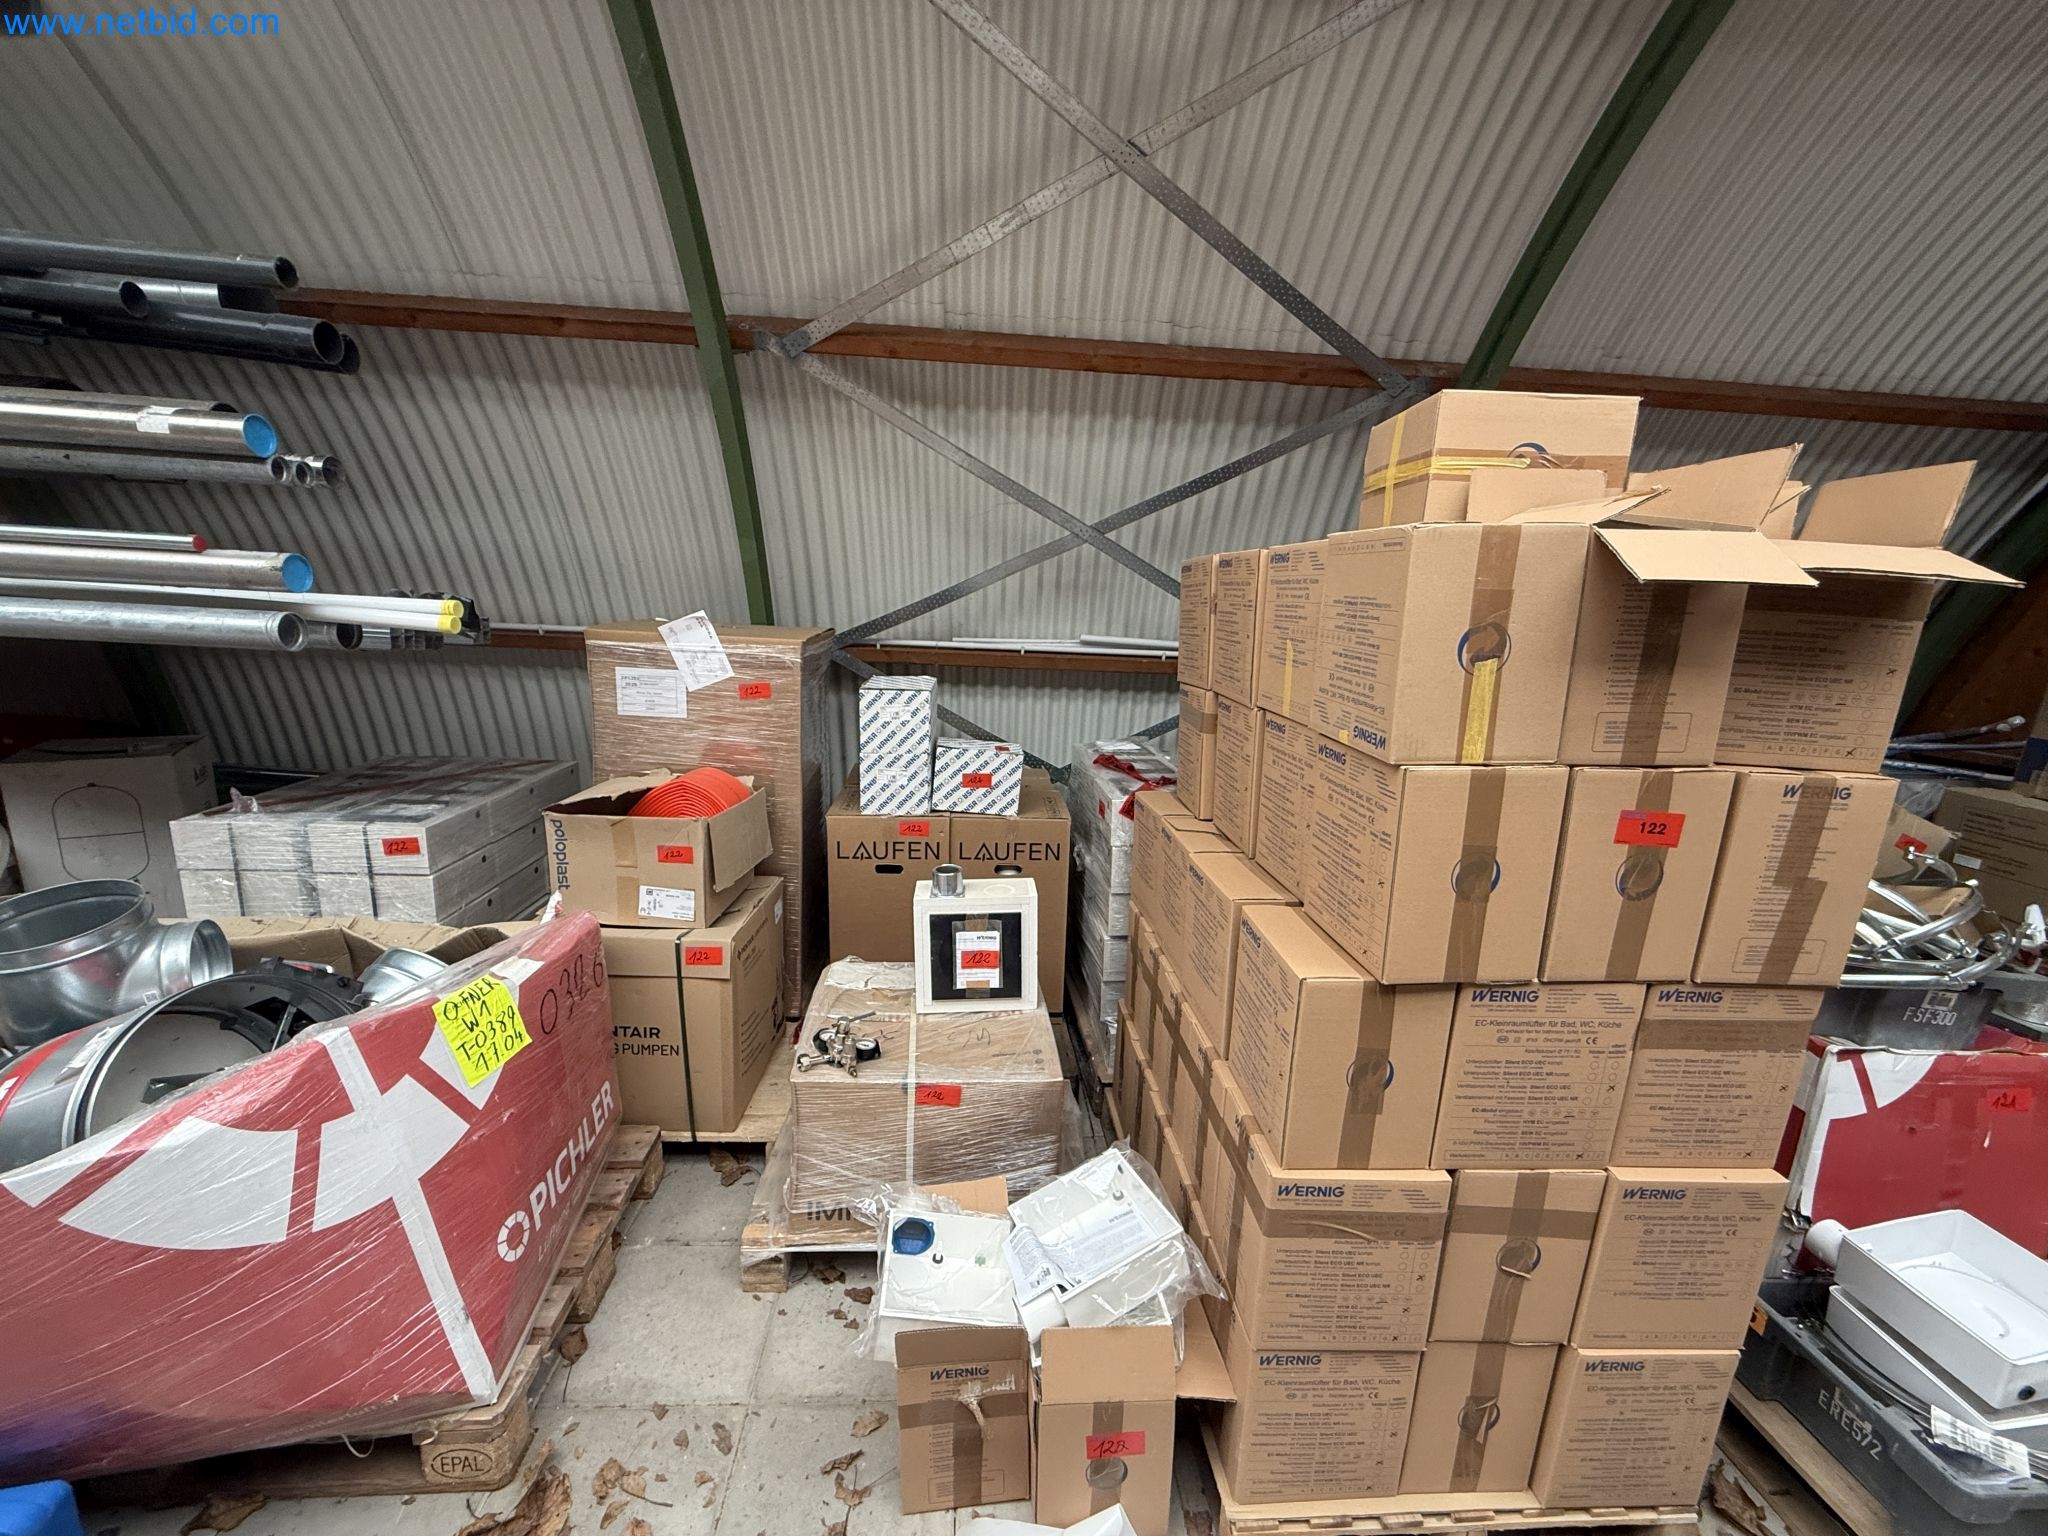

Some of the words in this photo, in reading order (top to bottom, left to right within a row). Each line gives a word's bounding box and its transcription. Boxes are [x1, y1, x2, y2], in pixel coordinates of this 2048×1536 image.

[745, 686, 762, 696] 122
[864, 690, 885, 710] HANSA
[876, 730, 897, 750] HANSA
[896, 727, 917, 748] HANSA
[1353, 726, 1386, 750] WERNIG
[1318, 743, 1346, 766] WERNIG
[863, 754, 884, 774] HANSA
[948, 761, 971, 780] HANSA
[895, 790, 916, 810] HANSA
[1783, 783, 1852, 800] WERNIG
[876, 792, 897, 813] HANSA
[903, 824, 923, 833] 122
[1639, 822, 1667, 835] 122
[387, 841, 408, 854] 122
[550, 819, 571, 890] poloplast
[664, 850, 684, 860] 122
[837, 841, 940, 861] LAUFEN
[959, 842, 1060, 862] LAUFEN
[1241, 917, 1261, 948] WERNIG
[688, 951, 710, 964] 122
[966, 953, 991, 964] 122
[1472, 988, 1539, 1002] WERNIG
[1658, 988, 1724, 1003] WERNIG
[1474, 1019, 1546, 1028] EC-Kleinraumlüfter
[1548, 1020, 1559, 1028] für
[1903, 1007, 1958, 1026] FSF300
[475, 1028, 523, 1071] 17.04
[622, 1043, 680, 1056] PUMPEN
[924, 1090, 944, 1100] 122
[529, 1080, 614, 1232] PICHLER
[1277, 1183, 1345, 1198] WERNIG
[1622, 1187, 1687, 1200] WERNIG
[1259, 1354, 1322, 1366] WERNIG
[1584, 1360, 1645, 1373] WERNIG
[930, 1367, 990, 1381] WERNIG
[1817, 1389, 1883, 1461] ERE572
[441, 1456, 485, 1473] EPAL
